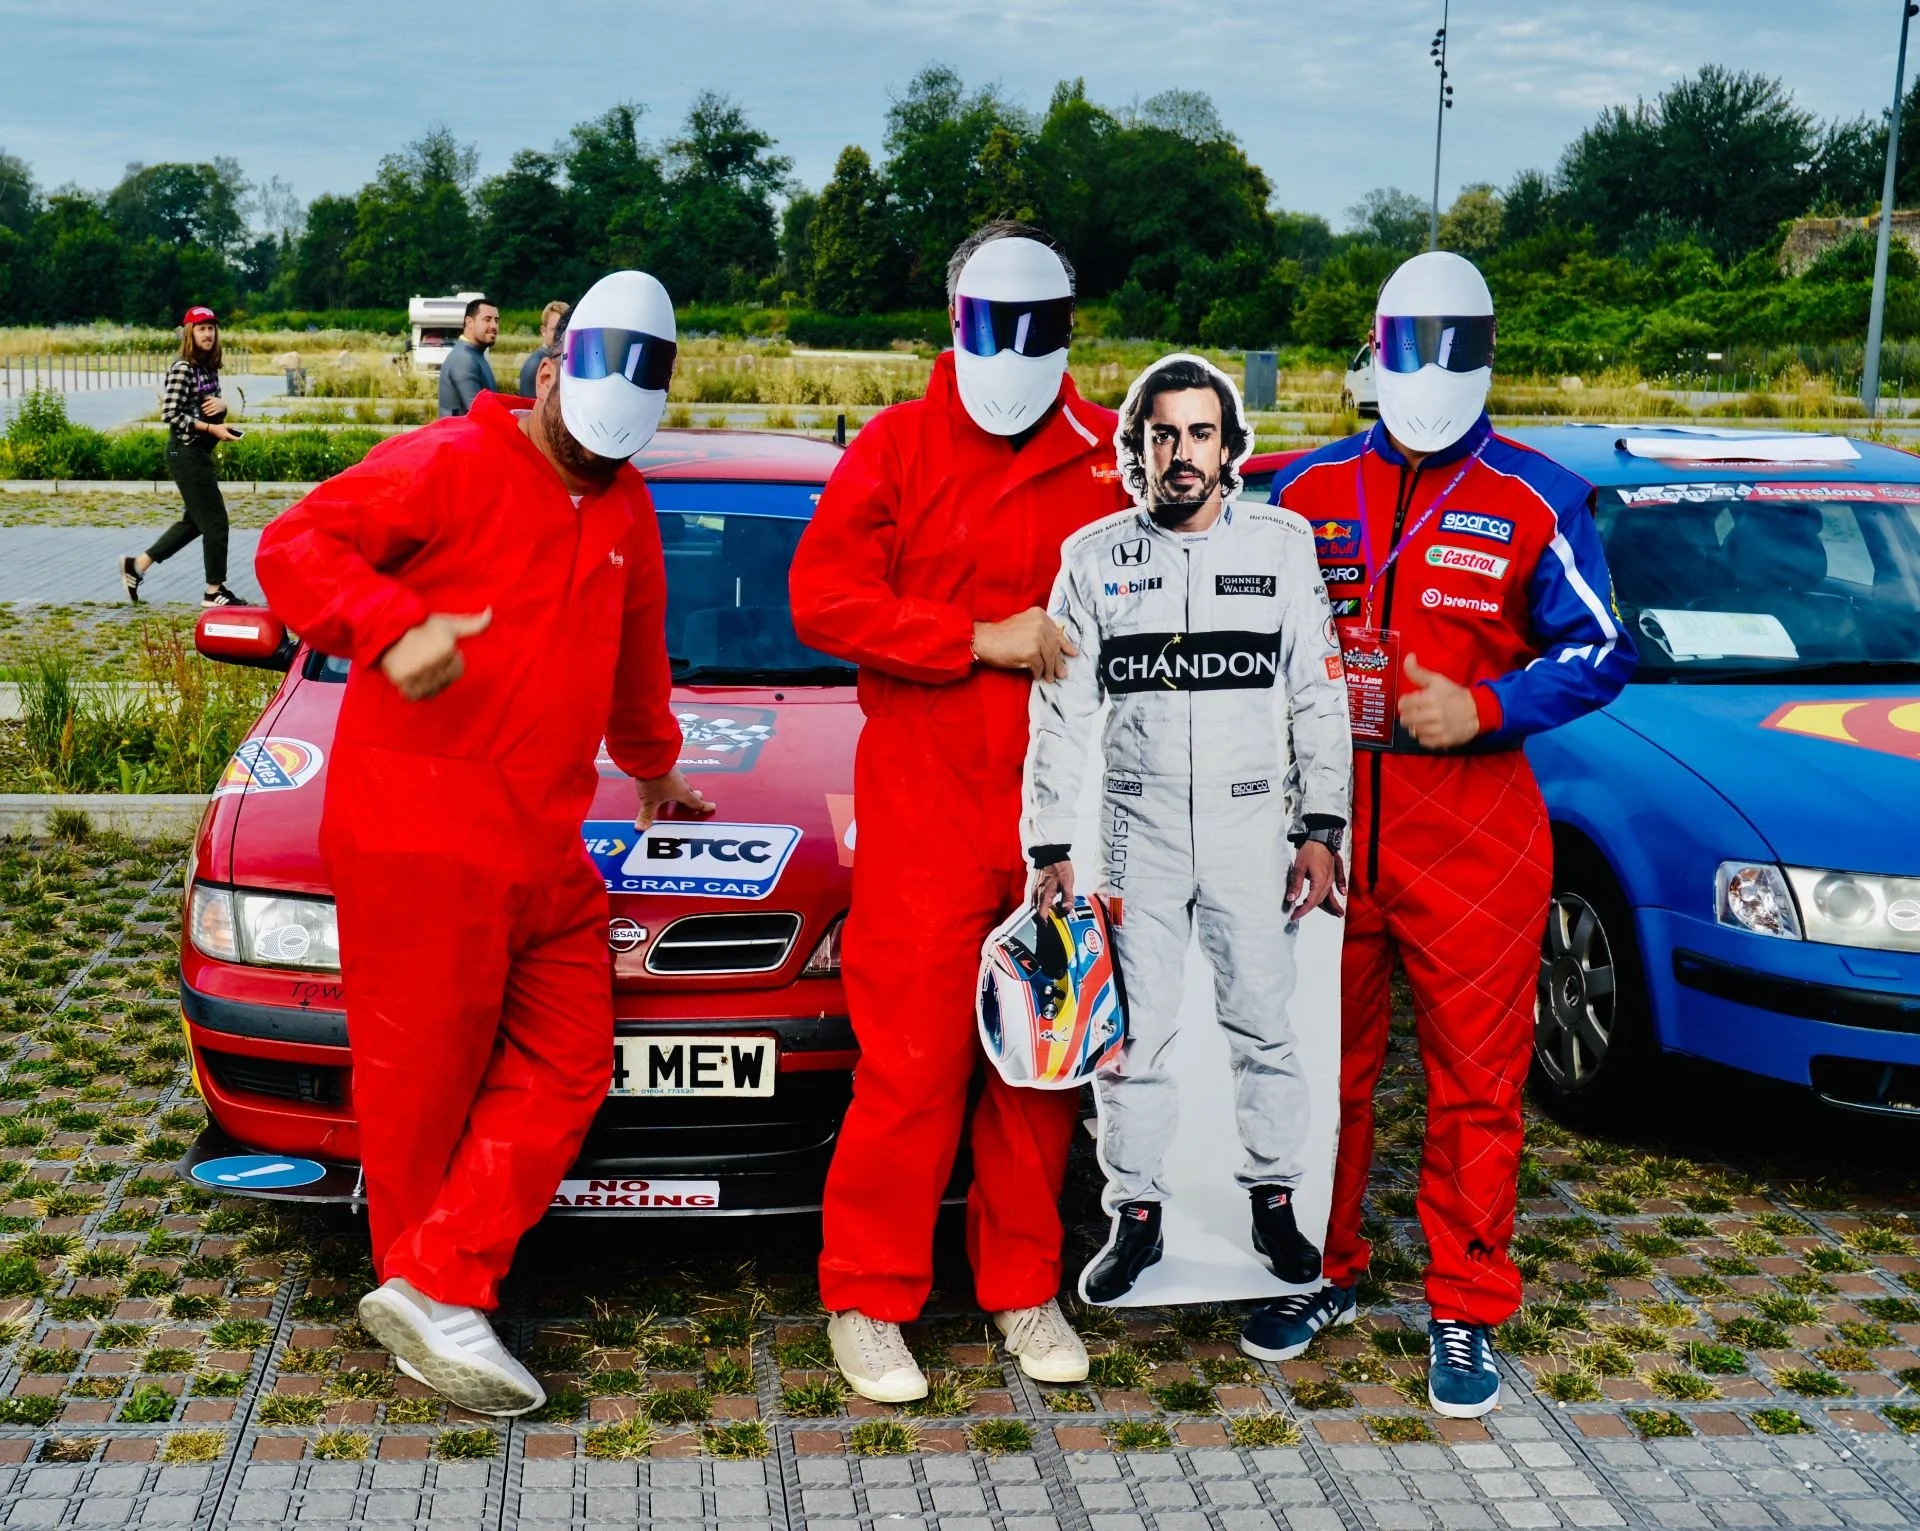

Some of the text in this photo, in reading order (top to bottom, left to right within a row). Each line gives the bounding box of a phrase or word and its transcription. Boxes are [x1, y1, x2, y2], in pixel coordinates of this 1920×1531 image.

[1757, 486, 1876, 498] Barcelona
[1105, 519, 1129, 531] MILLE
[1249, 514, 1308, 536] RICHARD MILLE
[1443, 512, 1511, 537] sparco
[1330, 541, 1357, 555] Bull
[1442, 550, 1496, 573] Castrol
[1220, 576, 1261, 585] JOHNNIE
[1320, 567, 1359, 581] CARO
[1104, 579, 1147, 597] Mobil
[1223, 585, 1261, 594] WALKER
[1442, 594, 1499, 613] brembo
[1108, 652, 1277, 682] CHANDON
[1346, 672, 1383, 685] Pit Lane
[239, 743, 282, 785] Dickies
[1108, 780, 1142, 793] sparco
[1232, 780, 1269, 794] sparco
[646, 837, 772, 864] BTCC
[1110, 804, 1129, 890] ALONSO
[622, 879, 696, 891] CRAP
[704, 882, 760, 895] CAR
[610, 930, 641, 939] ISSAN
[649, 1044, 765, 1089] MEW
[588, 1180, 650, 1192] NO
[550, 1194, 715, 1206] ARKING
